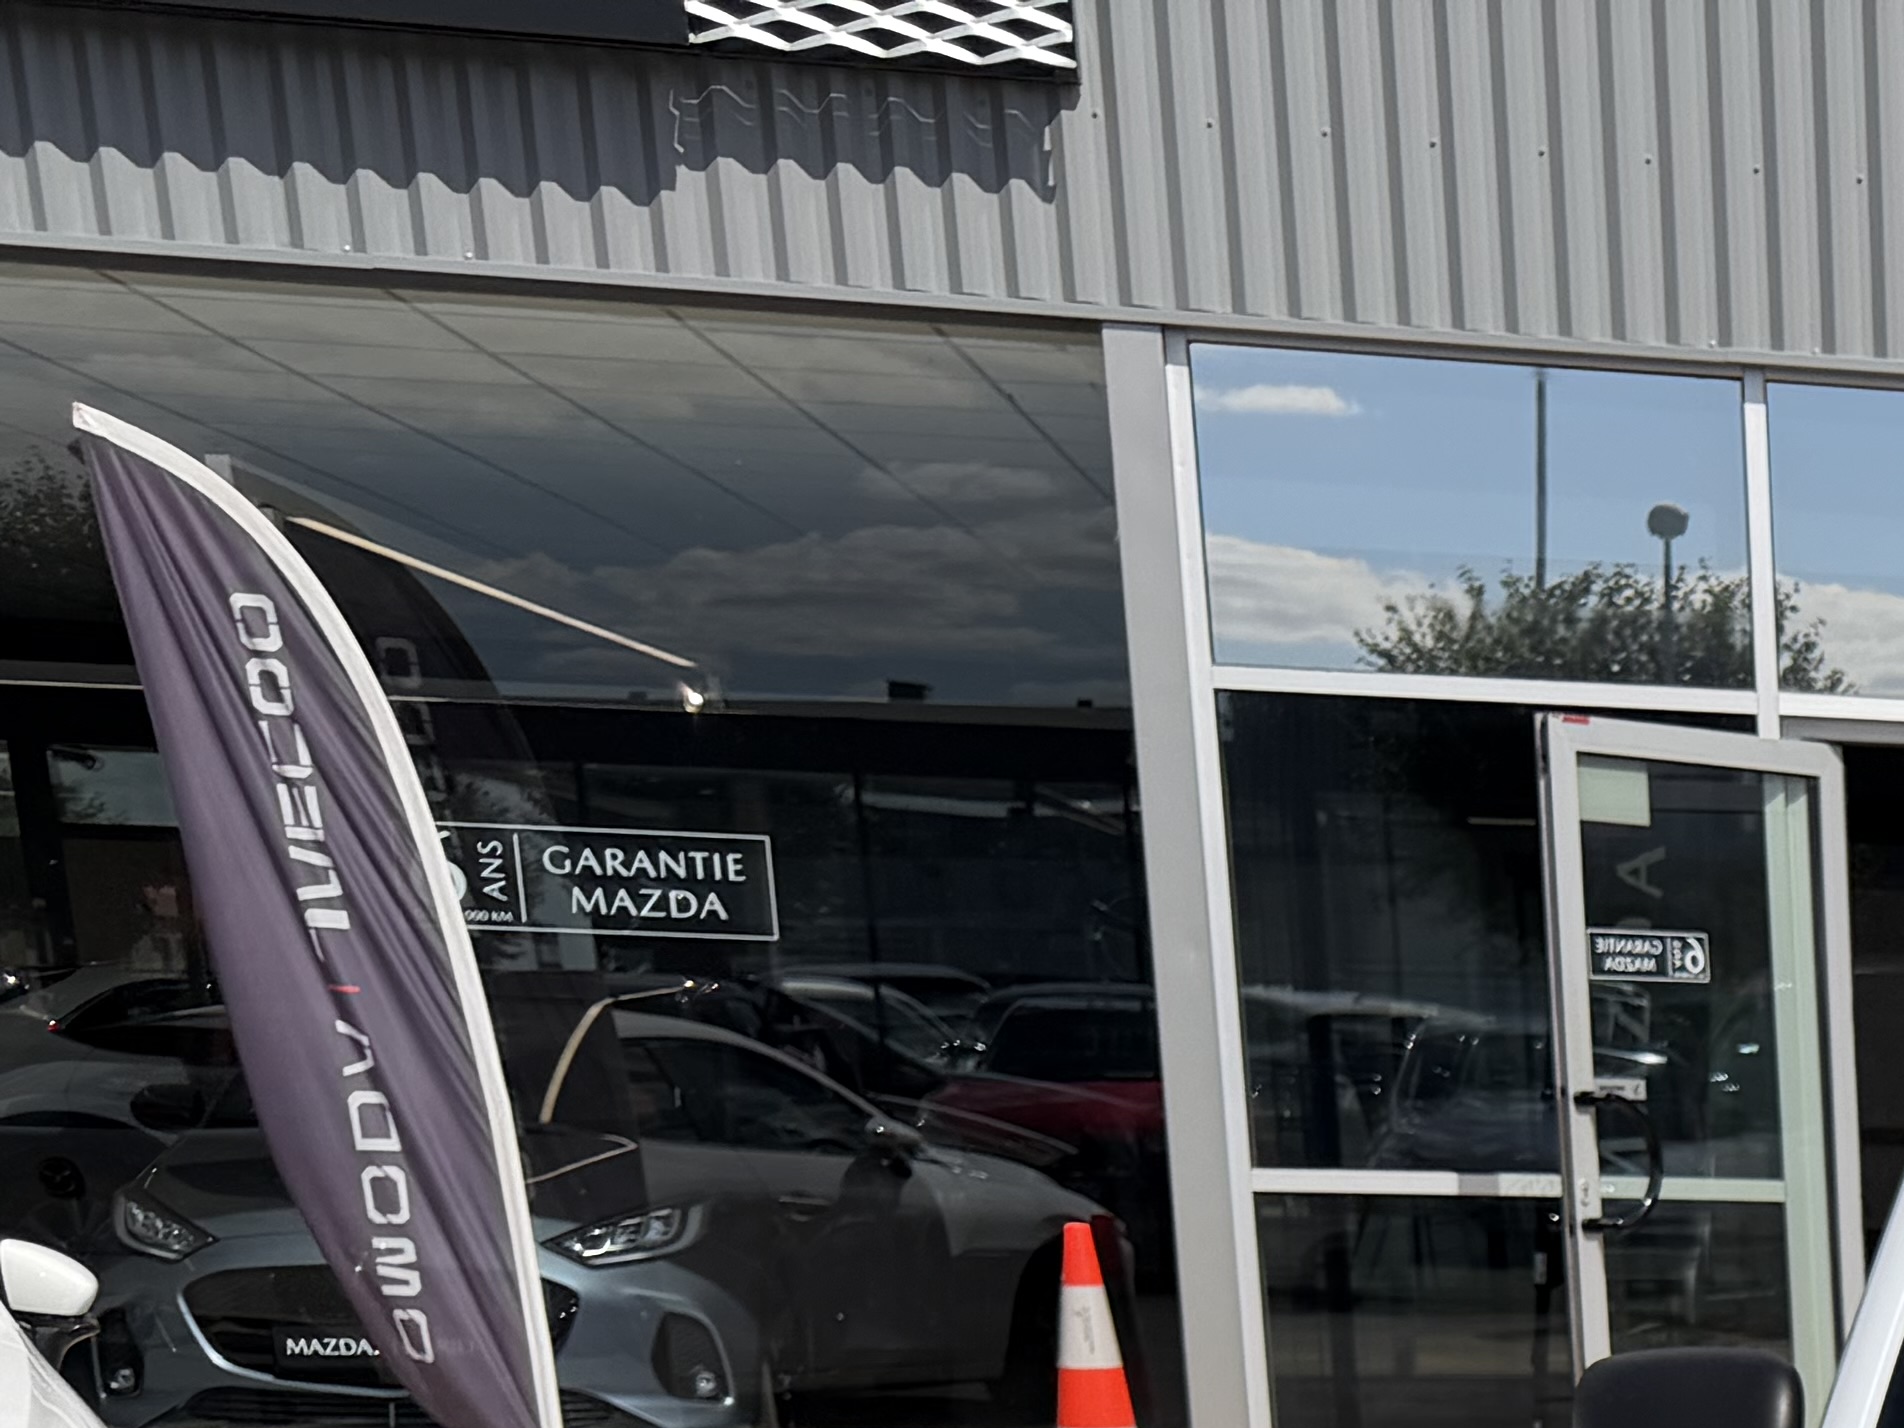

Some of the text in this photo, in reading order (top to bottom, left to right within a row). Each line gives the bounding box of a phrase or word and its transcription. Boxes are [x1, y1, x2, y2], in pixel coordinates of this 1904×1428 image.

[476, 840, 508, 902] ANS
[541, 844, 747, 882] GARANTIE
[571, 886, 729, 921] MAZDA
[286, 1338, 381, 1356] MAZDA
